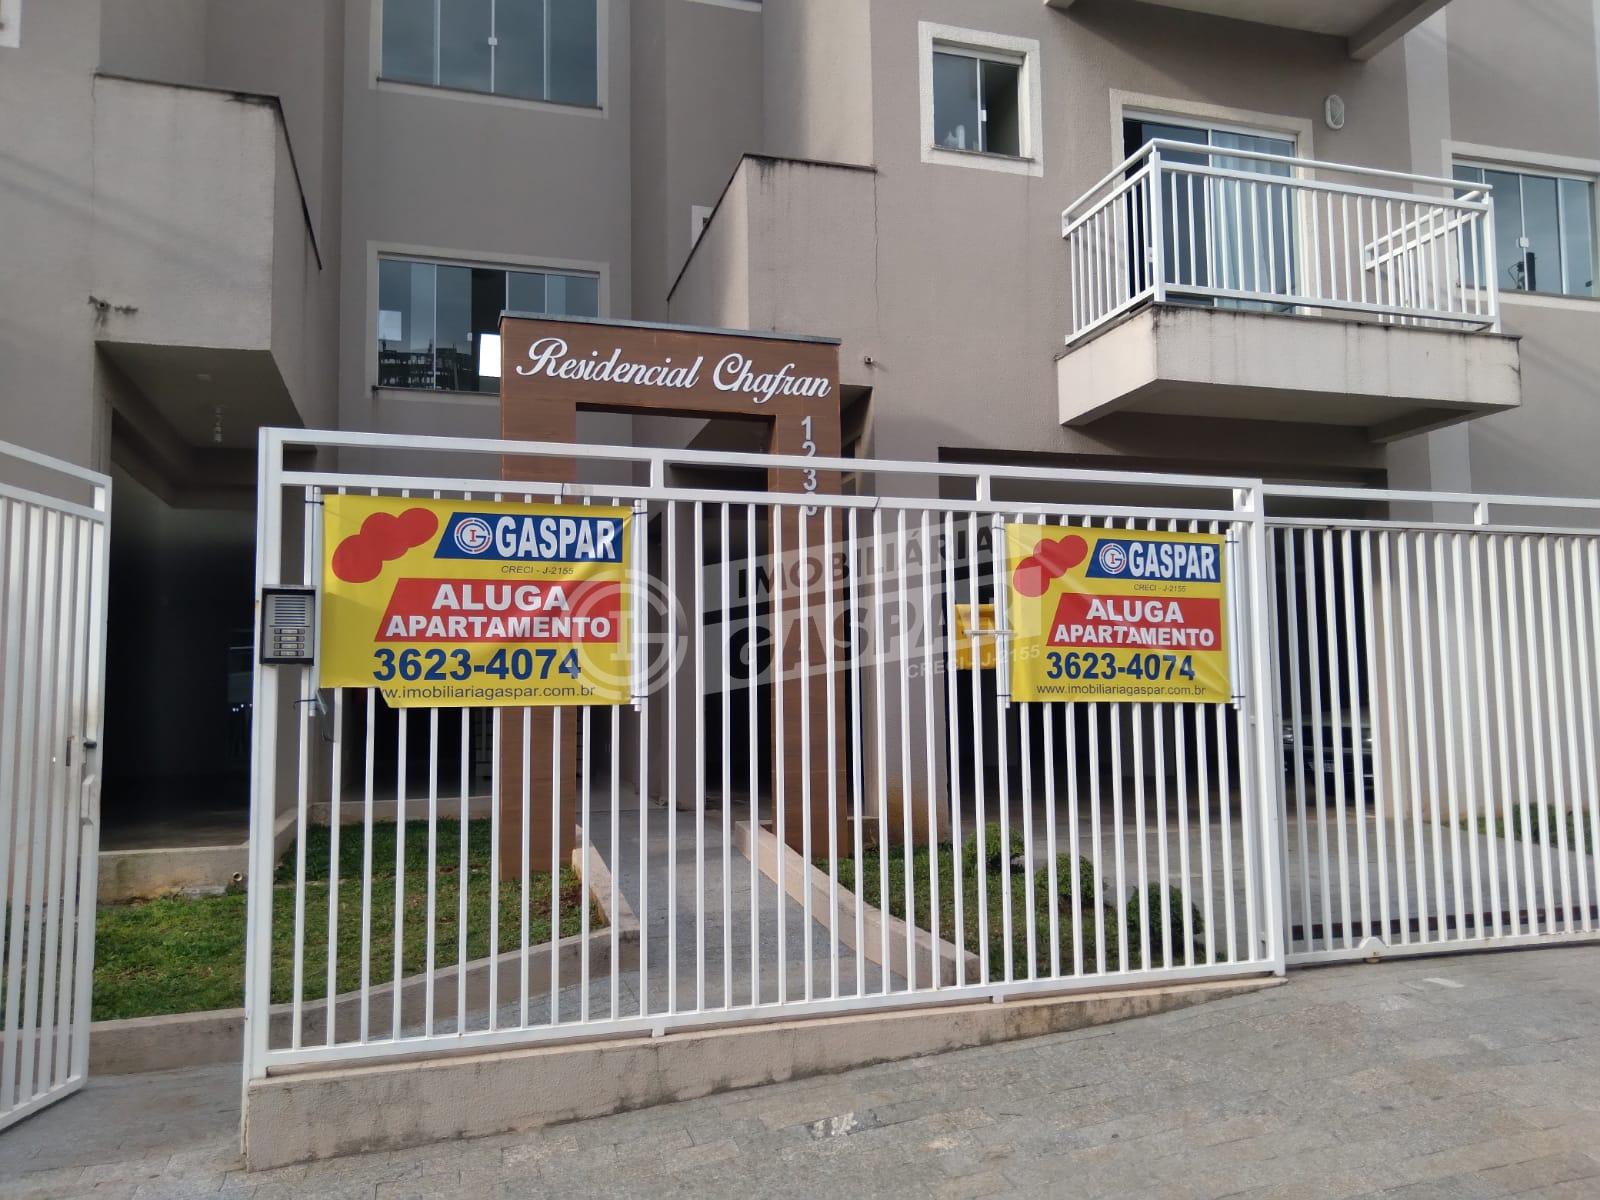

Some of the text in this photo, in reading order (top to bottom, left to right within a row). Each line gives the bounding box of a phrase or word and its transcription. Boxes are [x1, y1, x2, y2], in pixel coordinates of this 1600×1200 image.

[516, 337, 831, 404] Residencial Chafran
[495, 516, 616, 558] GASPAR
[501, 565, 534, 574] CRECI
[542, 566, 575, 575] J-2155
[1129, 542, 1216, 579] GASPAR
[432, 583, 570, 611] ALUGA
[1134, 583, 1157, 592] CRECI
[1086, 599, 1184, 623] ALUGA
[385, 615, 611, 638] APARTAMENTO
[1054, 624, 1215, 646] APARTAMENTO
[373, 648, 582, 681] 3623-4074
[1046, 652, 1196, 680] 3623-4074
[383, 685, 596, 700] w.imobiliariagaspar.com.br
[1037, 683, 1206, 696] www.imobiliariagaspar.com.br
